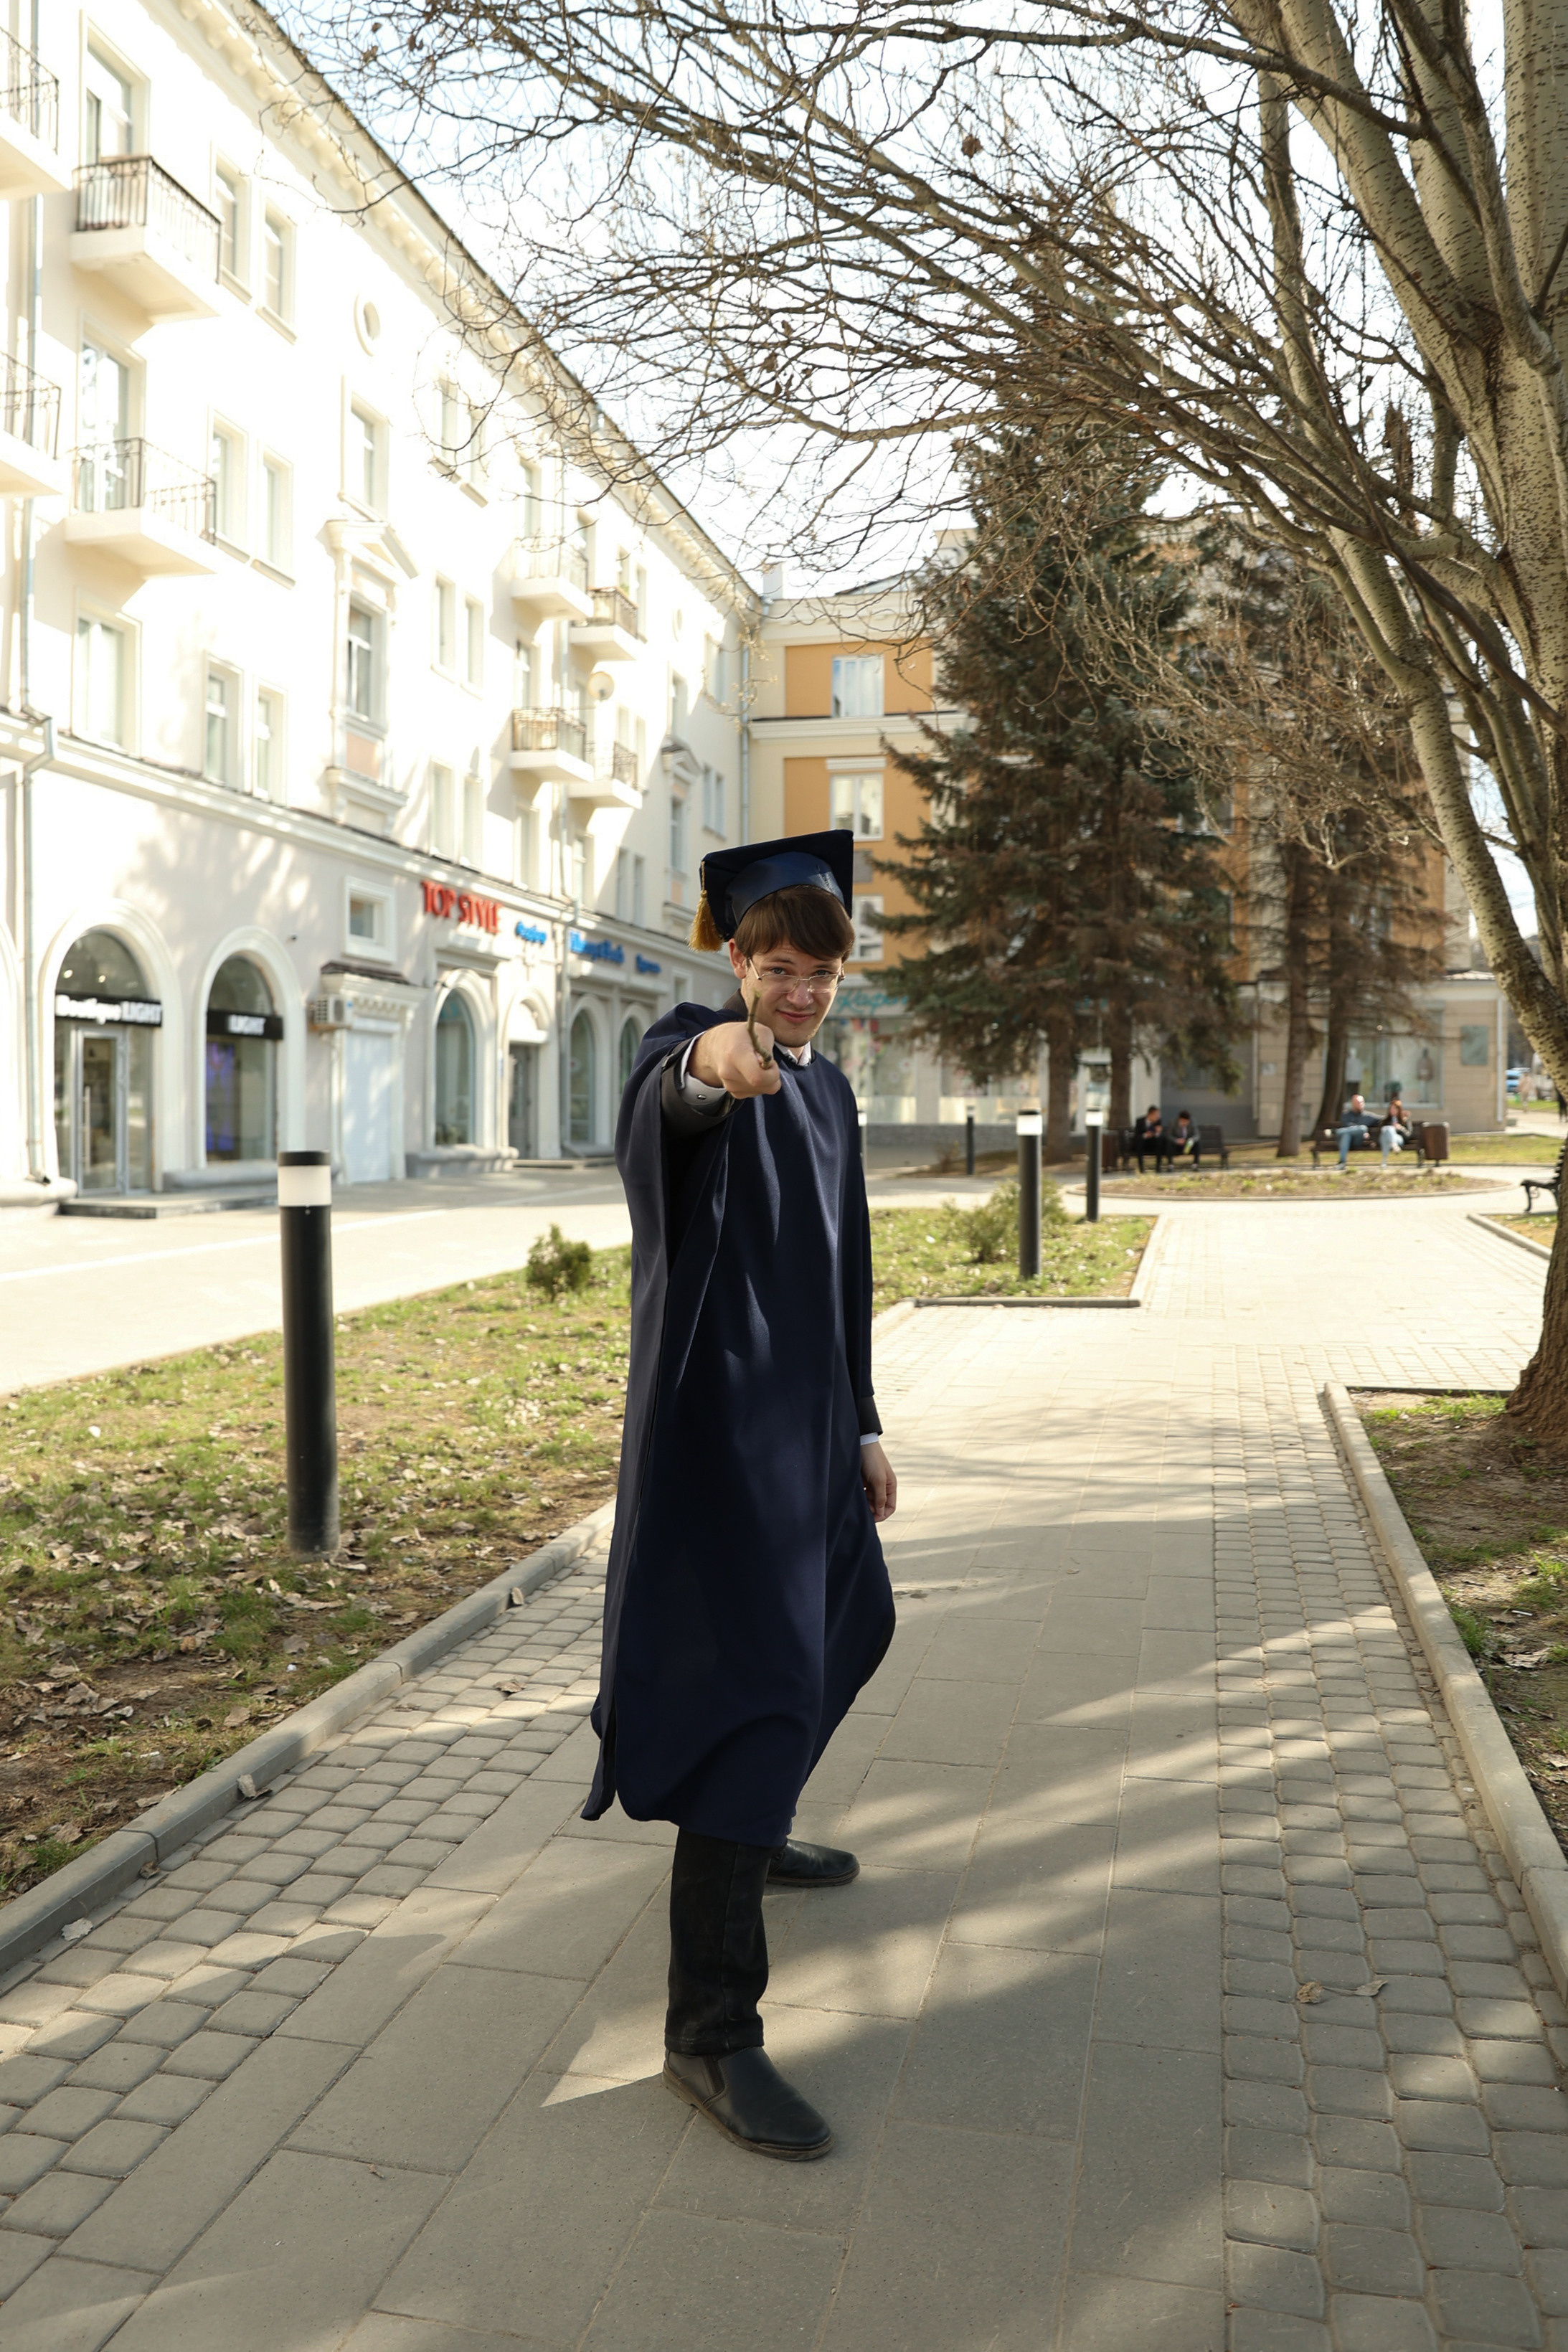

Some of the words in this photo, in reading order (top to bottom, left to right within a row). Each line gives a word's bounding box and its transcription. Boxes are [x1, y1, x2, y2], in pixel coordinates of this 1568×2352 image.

[420, 879, 456, 919] TOP
[458, 894, 503, 935] STYLE
[121, 1001, 162, 1024] LIGHT
[229, 1014, 266, 1036] LIGHT
